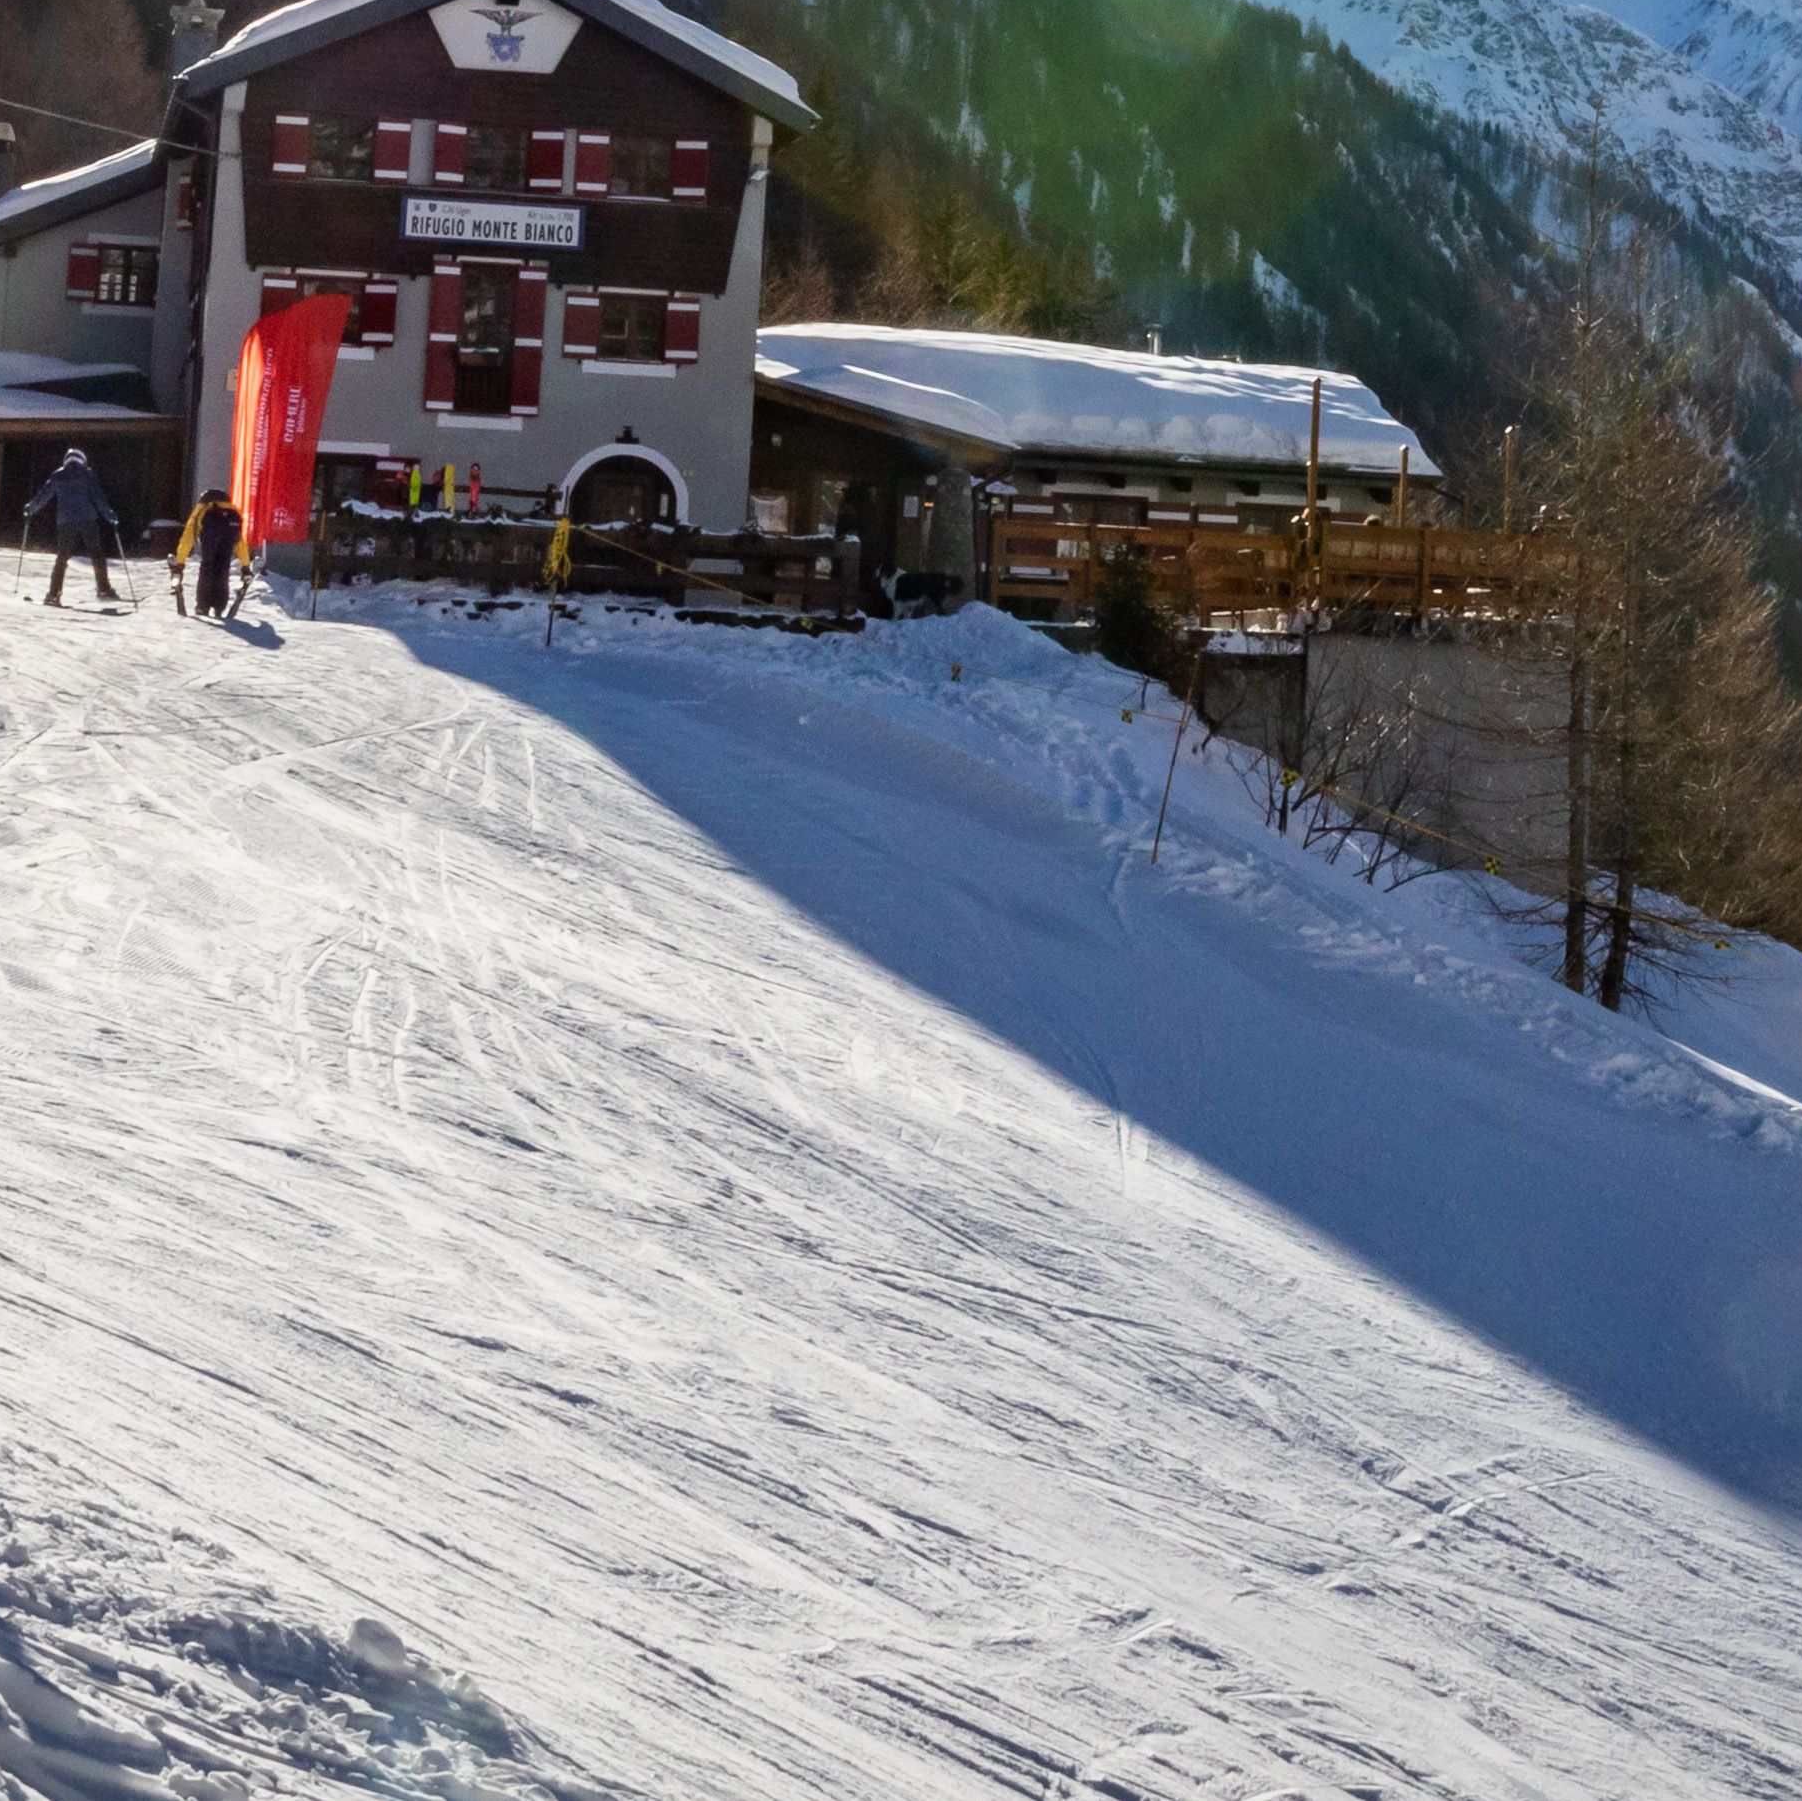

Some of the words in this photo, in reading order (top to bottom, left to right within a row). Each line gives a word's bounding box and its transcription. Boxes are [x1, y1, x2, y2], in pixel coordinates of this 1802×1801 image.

[411, 215, 465, 237] RIFUGIO
[472, 219, 518, 240] MONTE
[524, 222, 573, 243] BIANCO
